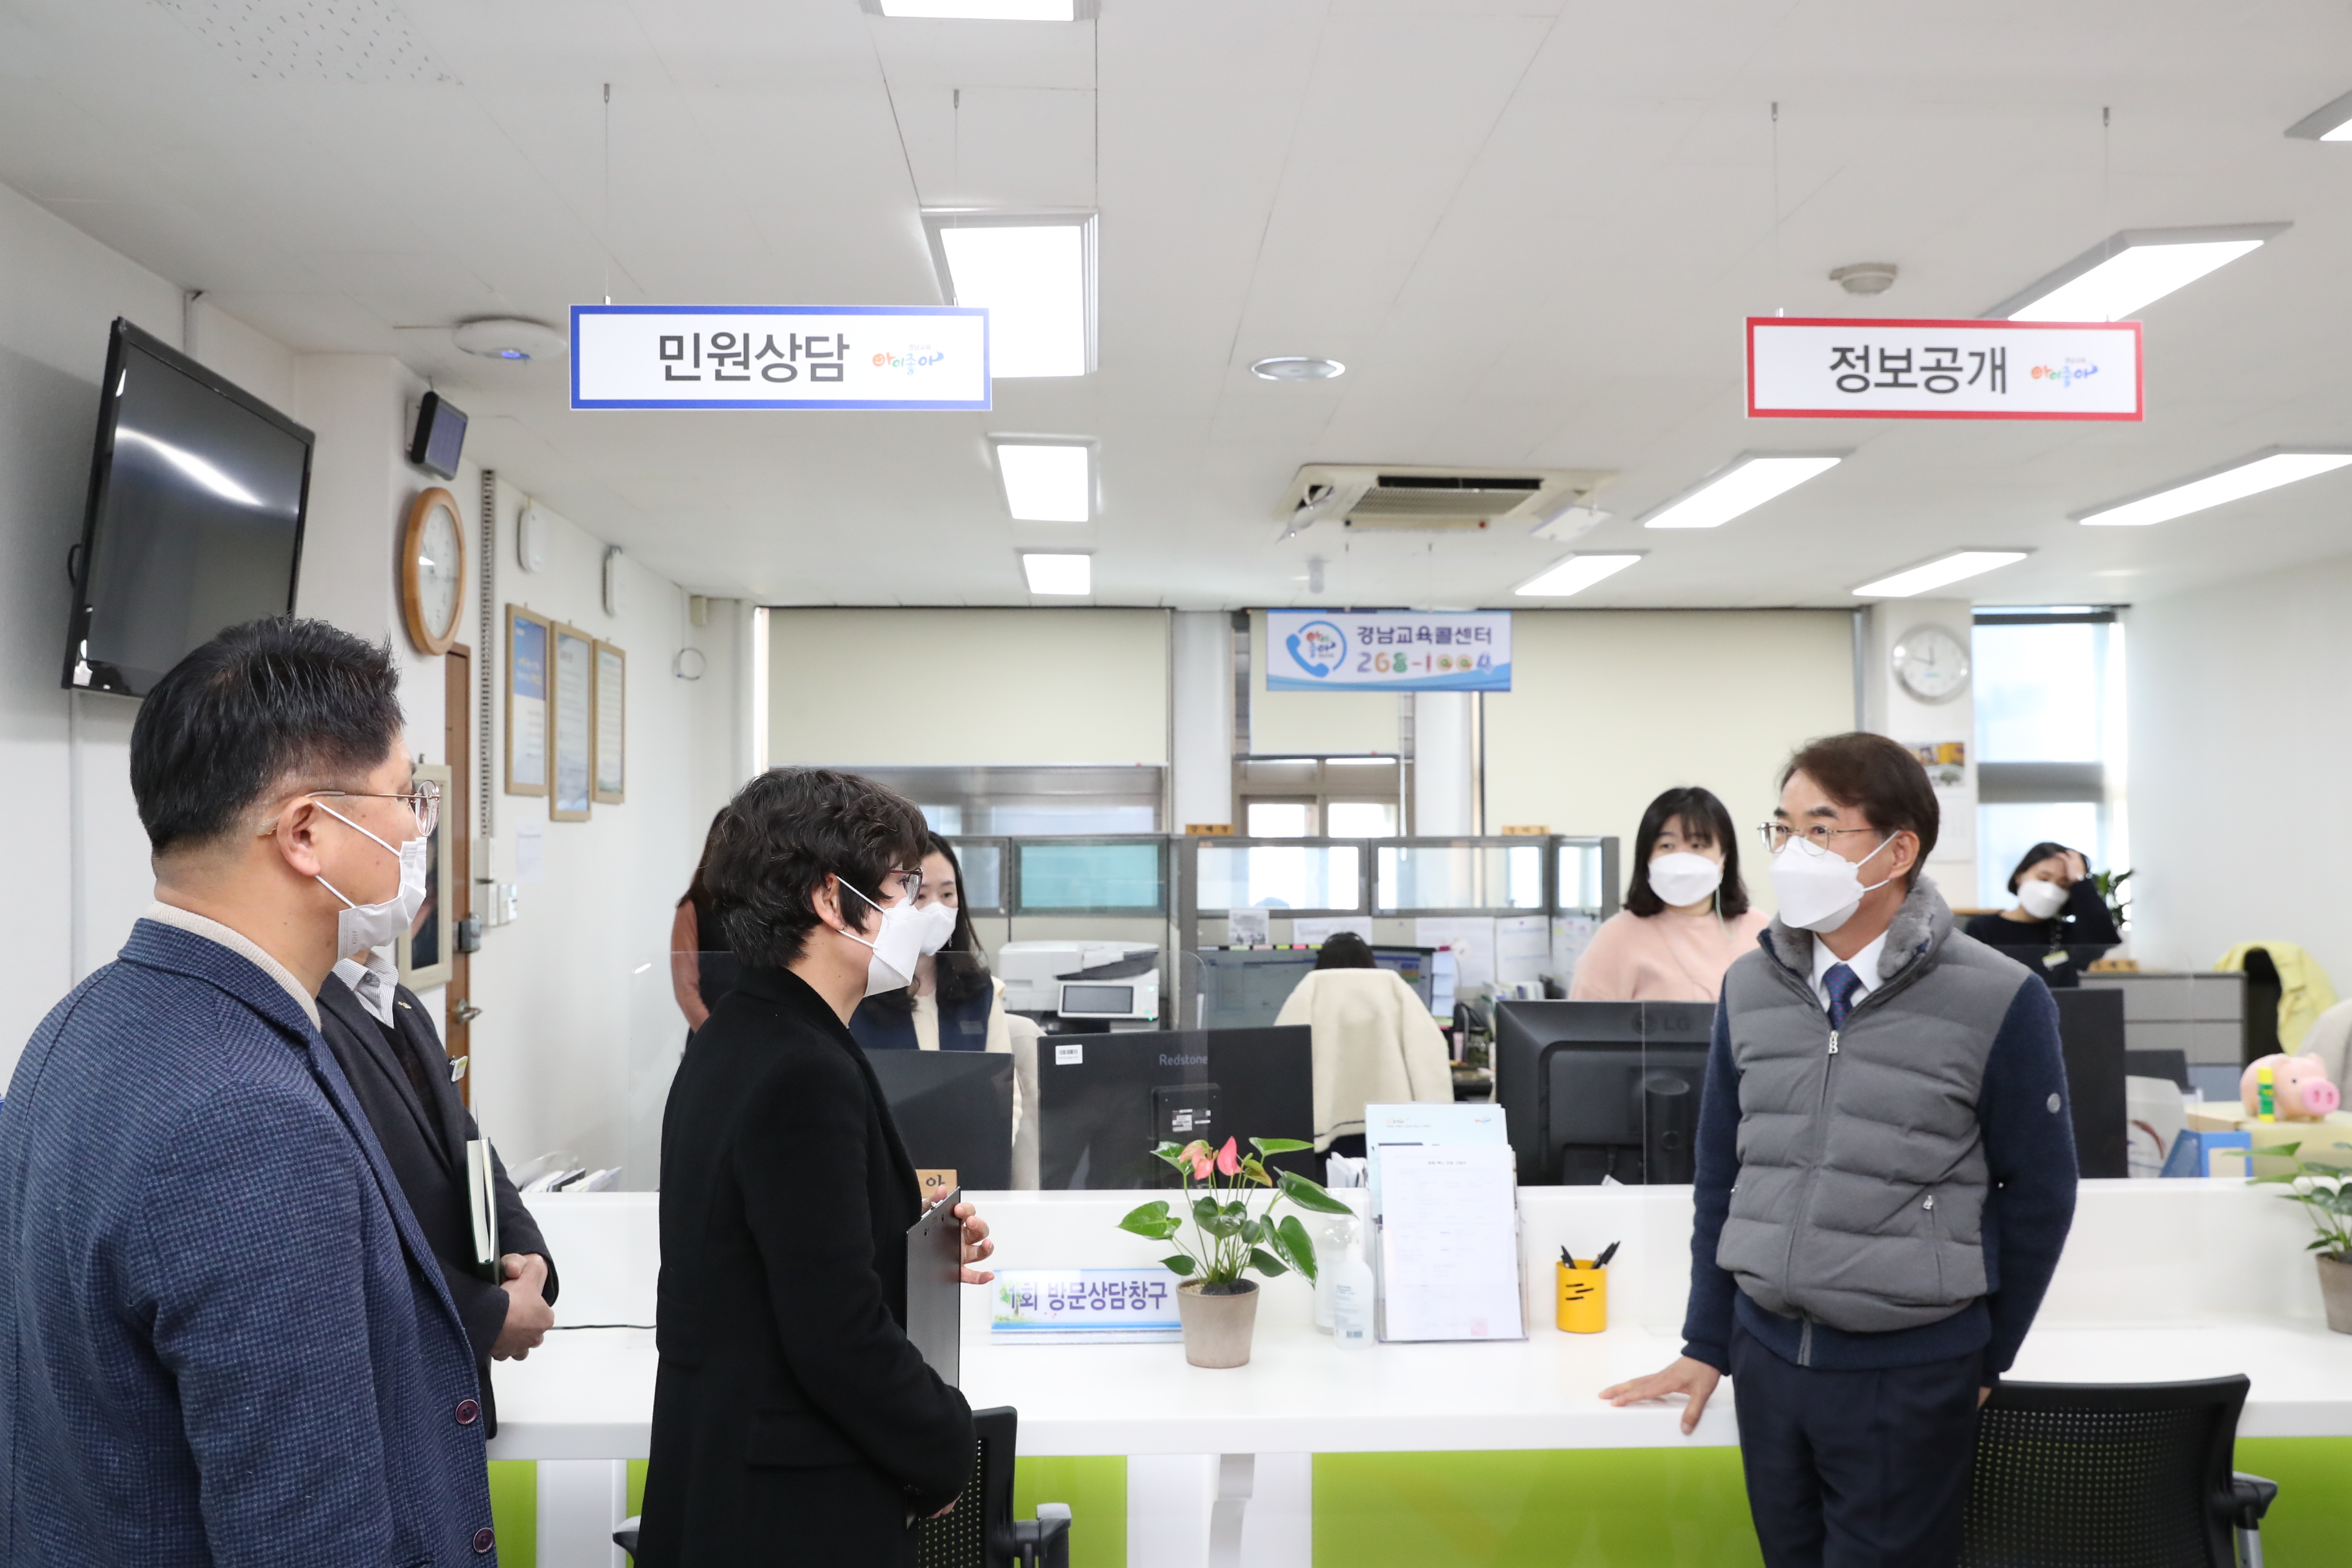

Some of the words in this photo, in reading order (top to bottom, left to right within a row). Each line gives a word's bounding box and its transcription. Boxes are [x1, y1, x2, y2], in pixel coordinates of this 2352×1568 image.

[659, 331, 850, 383] 민원상담
[872, 351, 945, 375] 아이좋아
[1829, 344, 2008, 395] 정보공개
[1357, 625, 1492, 645] 경남교육콜센터
[1159, 1054, 1209, 1066] Redstone
[1048, 1280, 1168, 1311] 방문상담창구
